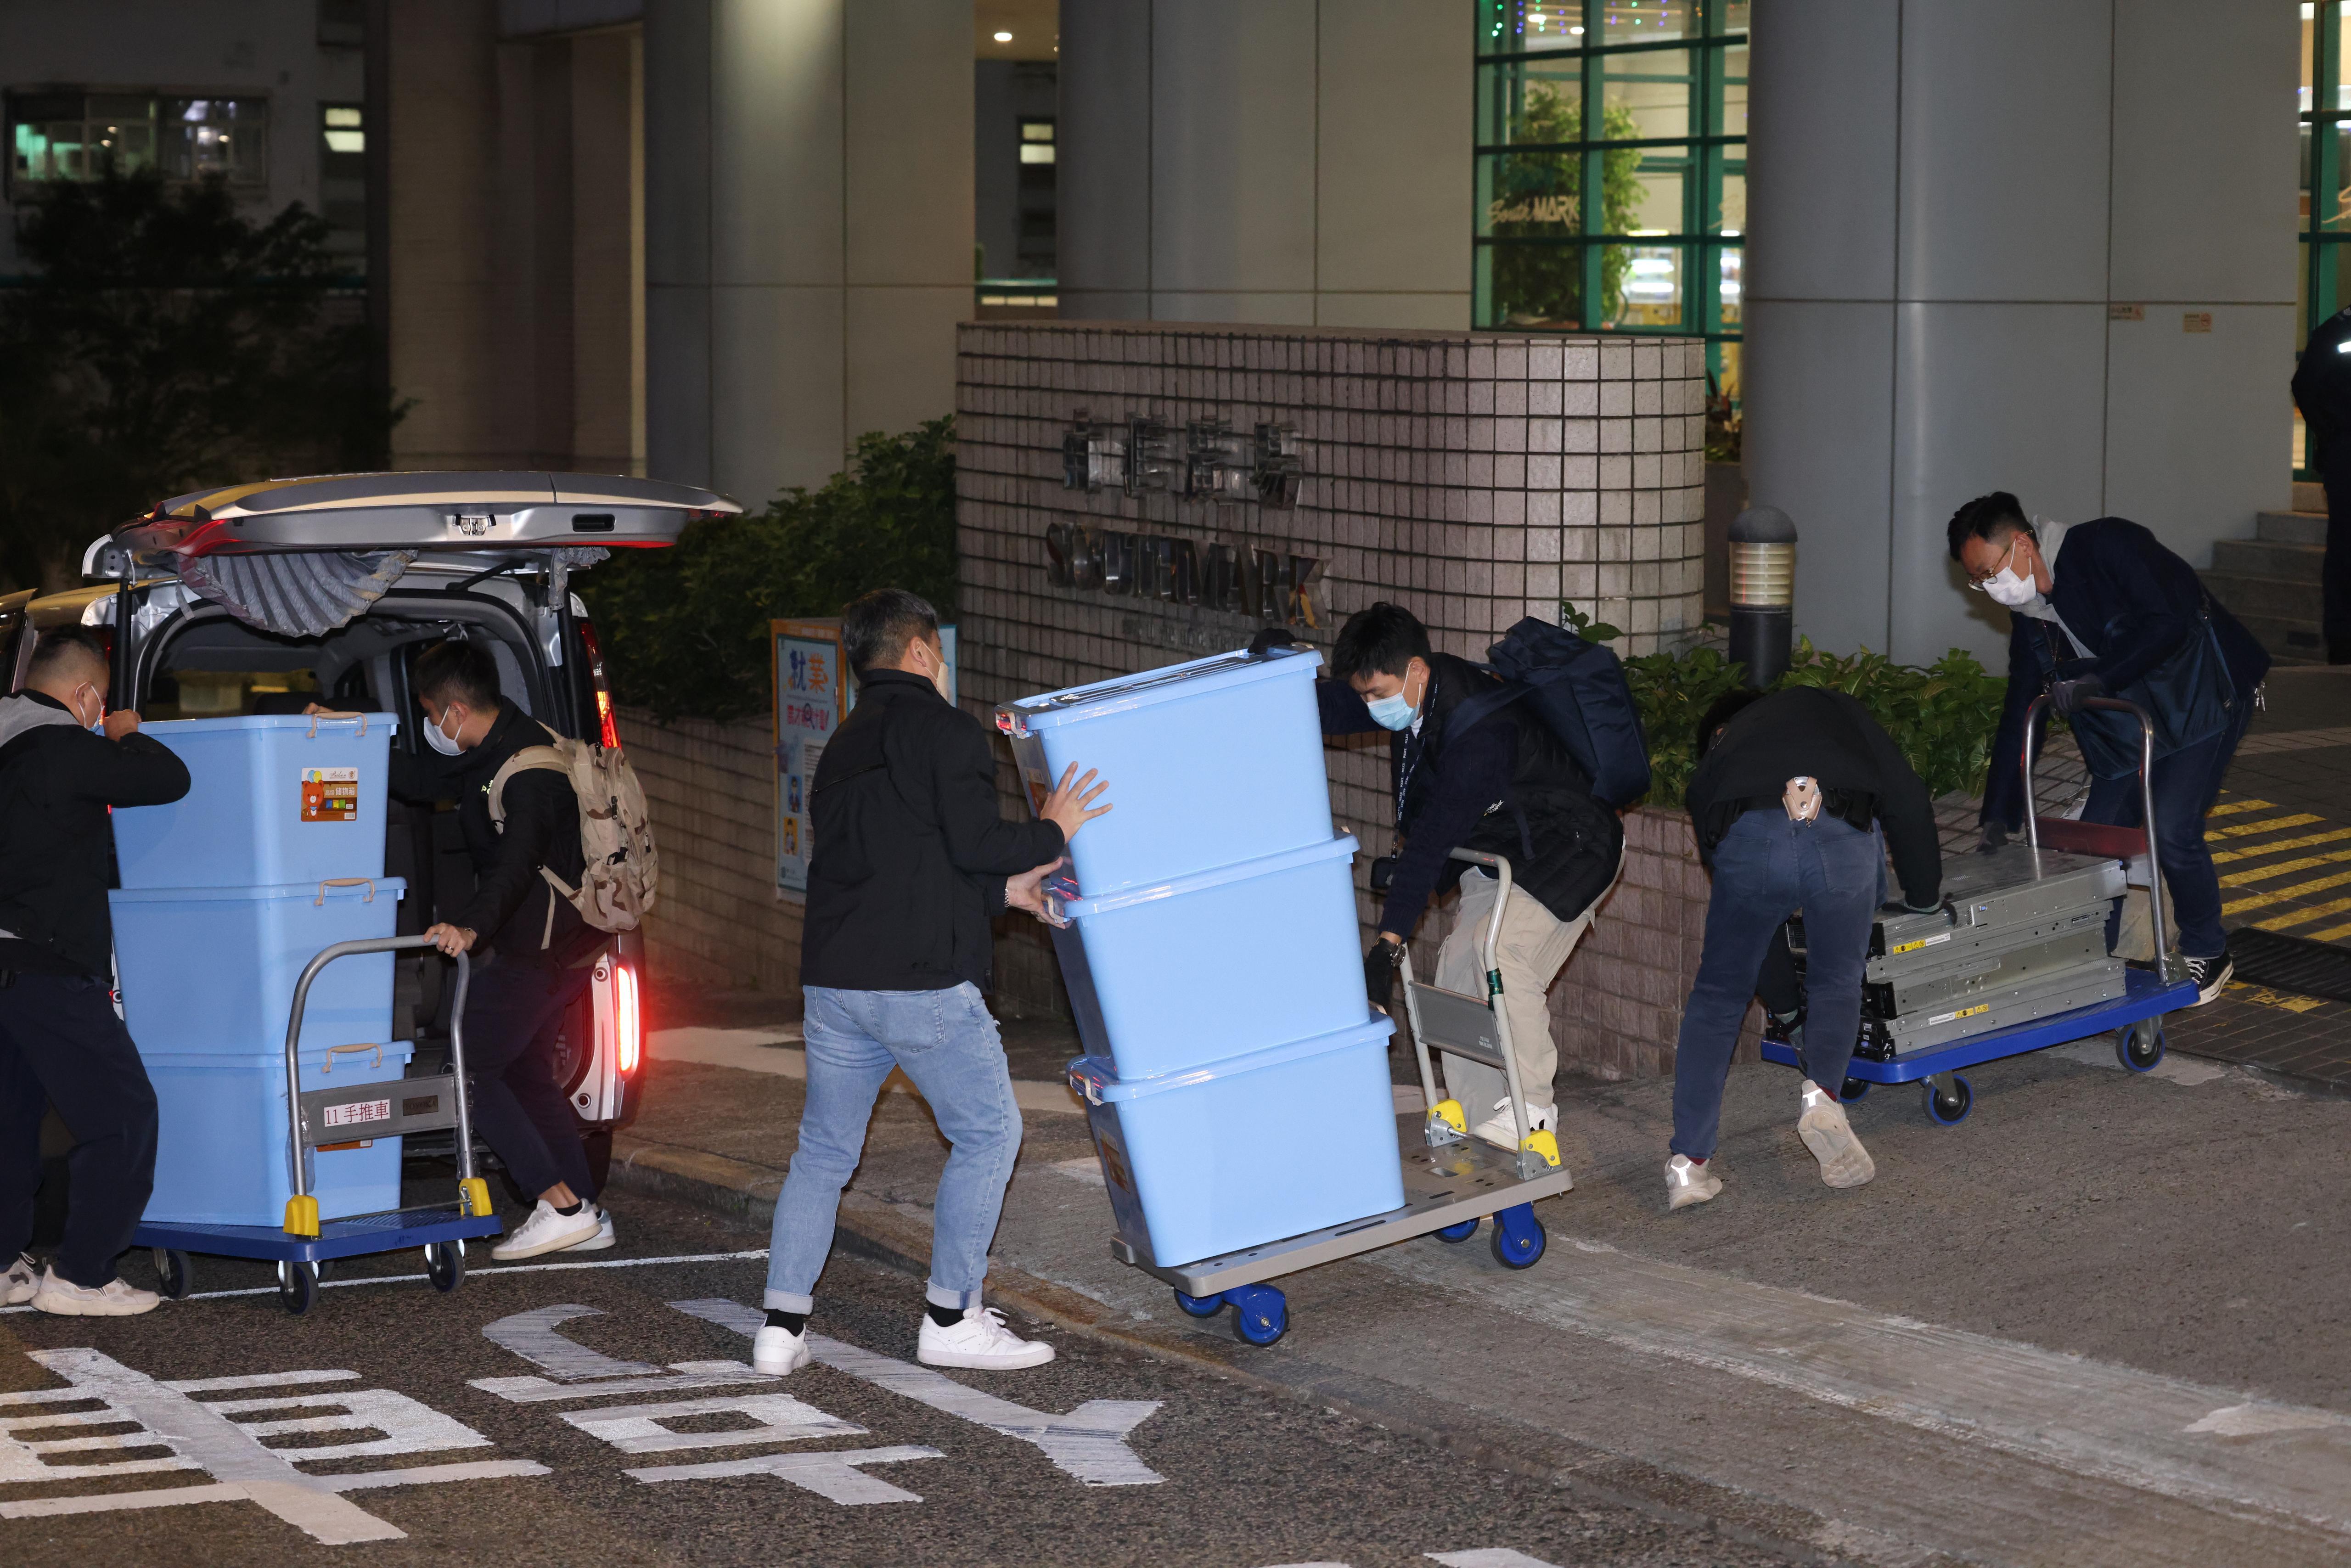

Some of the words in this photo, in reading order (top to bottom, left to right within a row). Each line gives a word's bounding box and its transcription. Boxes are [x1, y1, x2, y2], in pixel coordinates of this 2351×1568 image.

[336, 787, 355, 796] 储物箱
[1487, 799, 1504, 814] GRAPHIC
[326, 1109, 338, 1124] 11
[343, 1101, 389, 1123] 手推車
